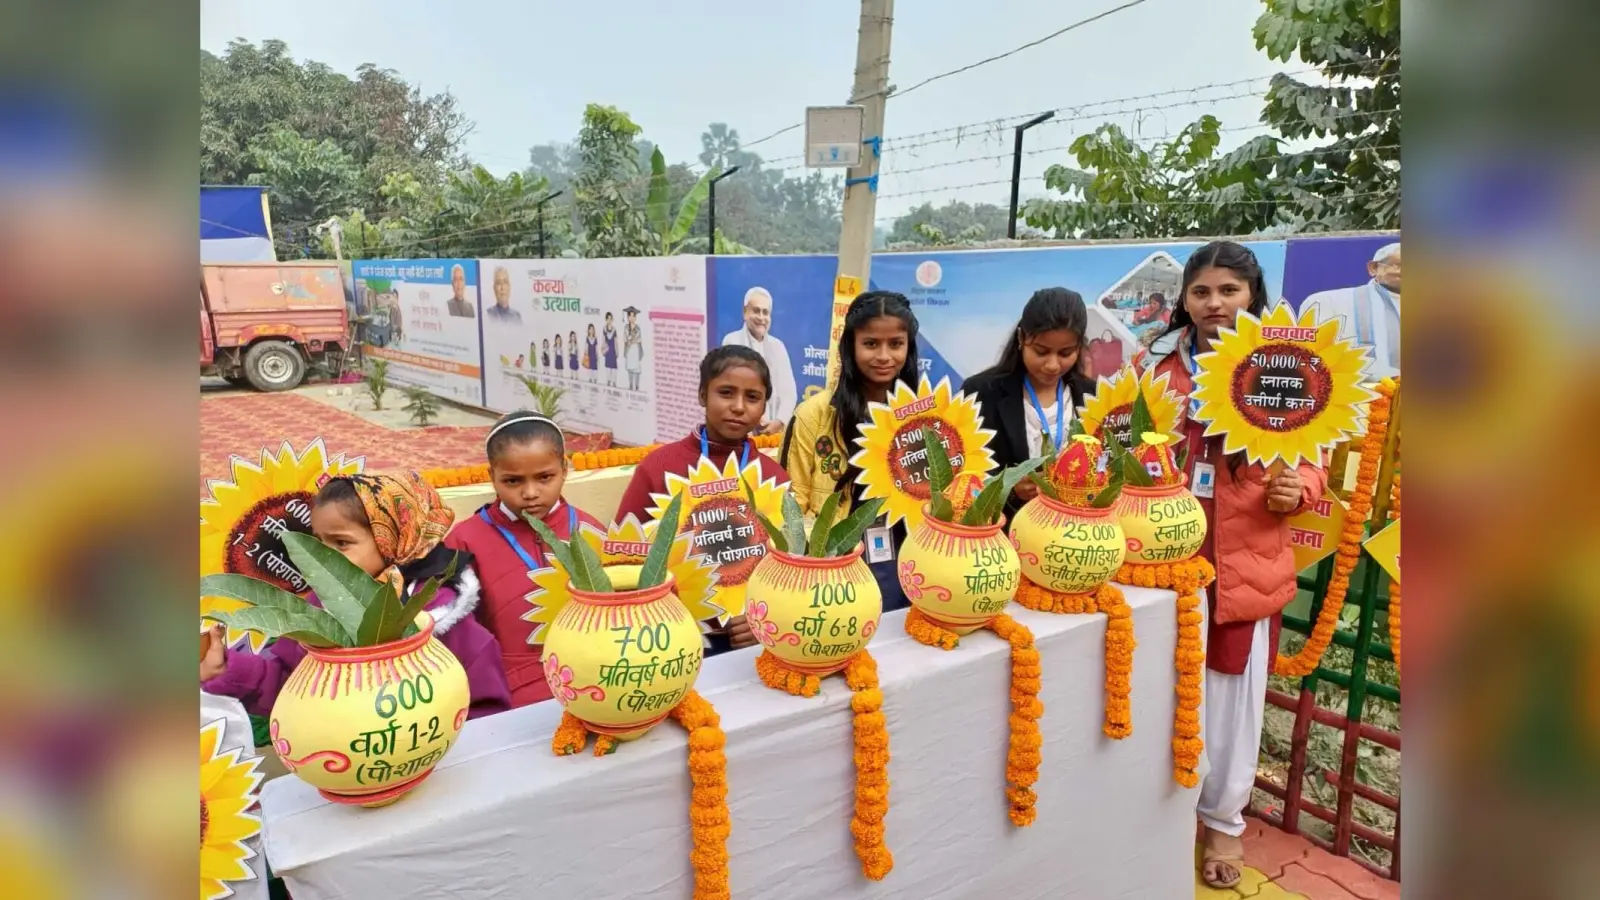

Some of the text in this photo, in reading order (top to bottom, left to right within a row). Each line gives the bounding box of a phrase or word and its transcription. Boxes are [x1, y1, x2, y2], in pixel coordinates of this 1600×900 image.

[532, 279, 564, 294] कन्या
[542, 296, 581, 312] उत्थान
[1261, 326, 1317, 341] धन्यवाद
[804, 345, 829, 360] प्रोत्सा
[1250, 353, 1320, 372] 50,000/- ₹
[802, 362, 828, 377] औद्यो
[1260, 375, 1304, 389] स्नातक
[894, 395, 936, 420] धन्यवाद
[1244, 391, 1316, 410] उत्तीर्ण करने
[1268, 416, 1286, 429] पर
[895, 428, 925, 449] 1500
[899, 447, 928, 468] प्रतिव
[689, 477, 739, 498] धन्यवाद
[691, 504, 747, 526] 1000/- ₹
[260, 515, 290, 539] प्रति
[694, 521, 755, 548] प्रतिवर्ष वर्ग
[1155, 520, 1200, 542] स्नातक
[1290, 527, 1324, 549] जना
[603, 540, 649, 557] धन्यवा
[717, 543, 766, 565] (पोशाक)
[972, 547, 1007, 567] 1500
[1140, 543, 1184, 561] उत्तीर्ण
[257, 550, 308, 592] (पोशाक)
[964, 566, 1007, 595] प्रतिवर्ष
[809, 581, 856, 608] 1000
[793, 610, 857, 637] वर्ग 6-8
[610, 622, 671, 657] 700
[802, 639, 860, 657] (पोशाक)
[598, 656, 660, 688] प्रतिवर्ष
[660, 647, 686, 680] वर्ग
[375, 673, 434, 719] 600
[617, 682, 688, 713] (पोशाक)
[350, 716, 444, 758] वर्ग 1-2
[356, 740, 449, 785] (पोशाक)
